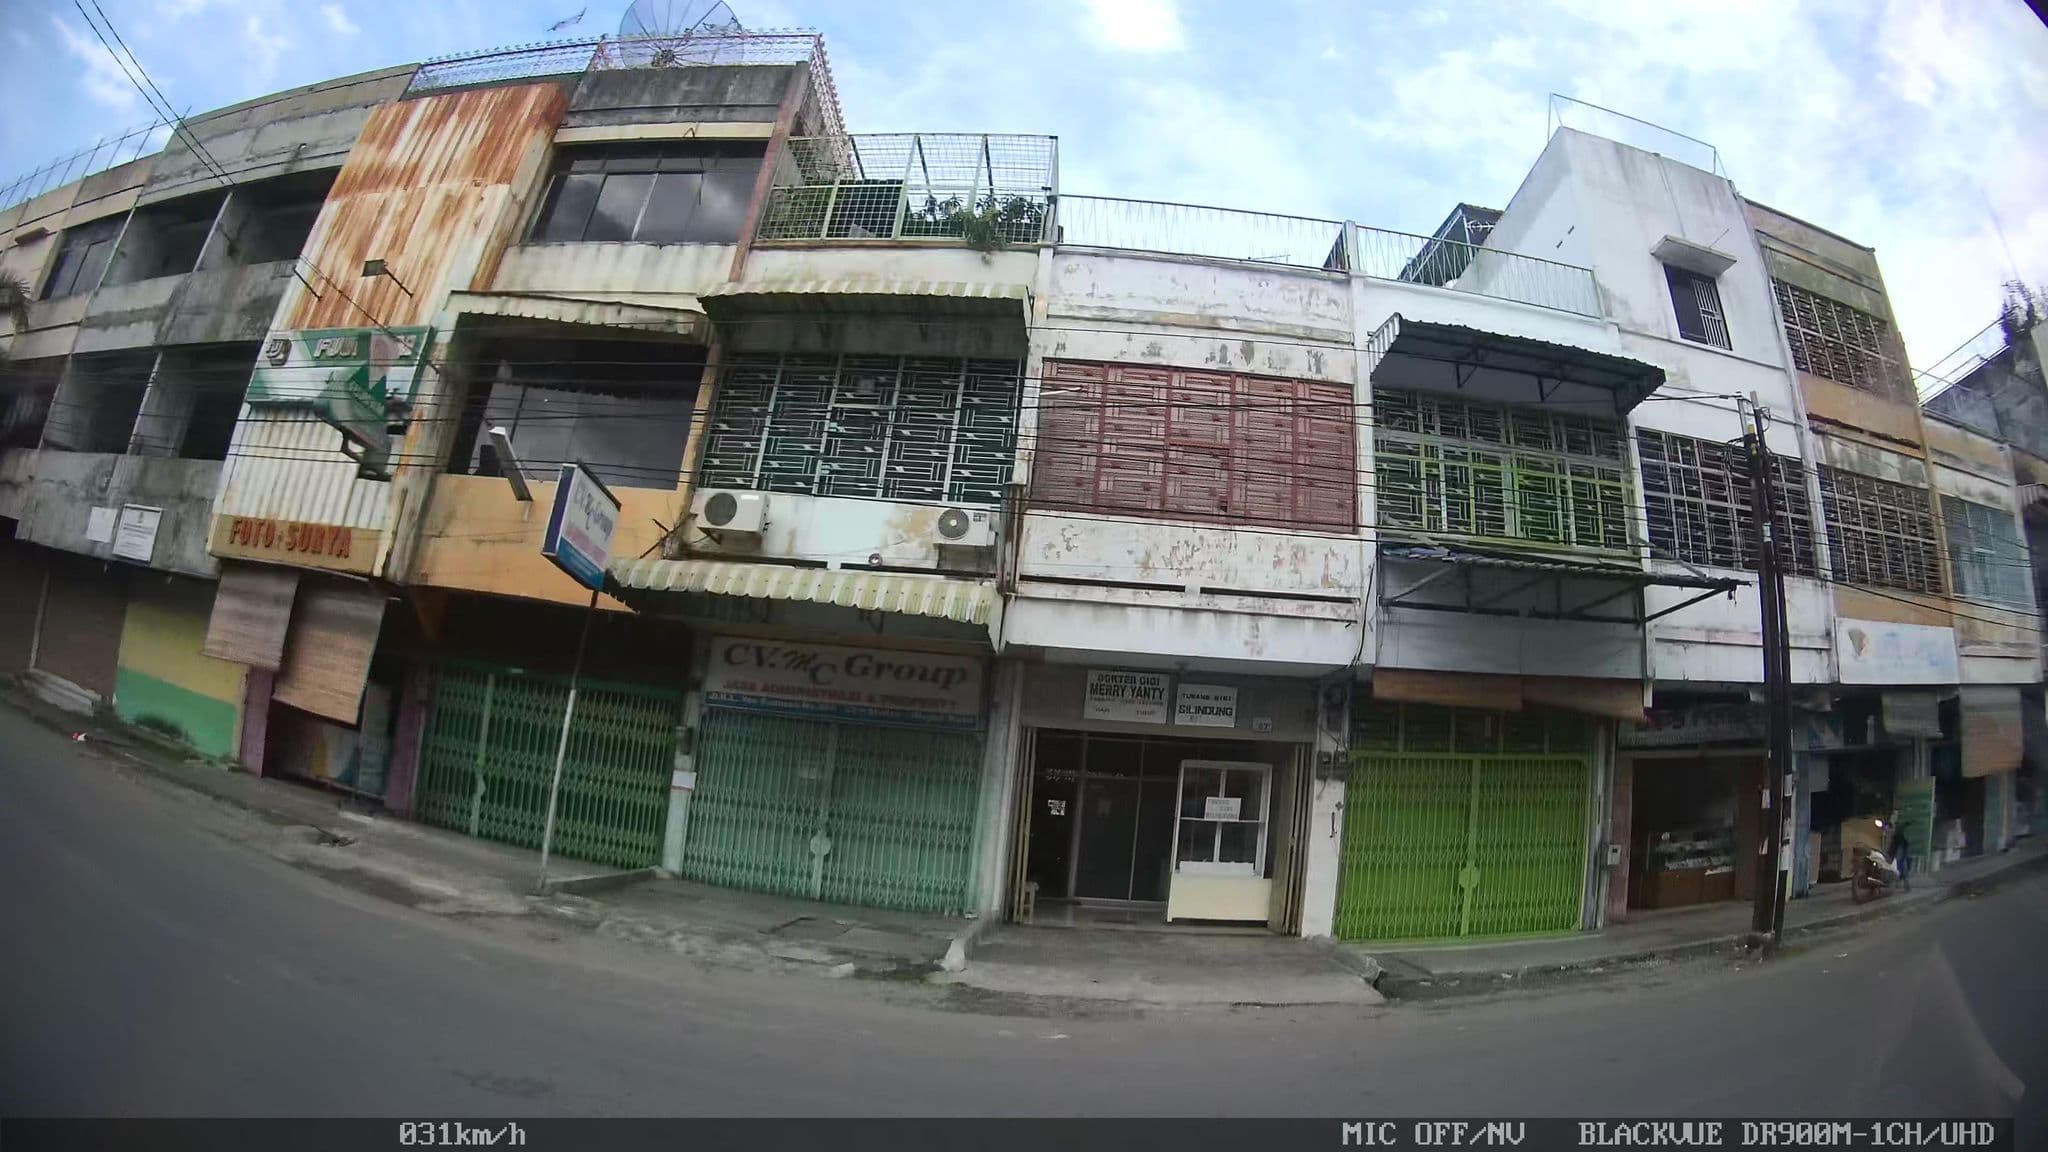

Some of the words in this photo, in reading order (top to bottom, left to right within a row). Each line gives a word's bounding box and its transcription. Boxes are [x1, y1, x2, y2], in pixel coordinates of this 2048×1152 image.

[313, 335, 359, 358] FUJI
[287, 522, 352, 559] SURYA
[844, 653, 968, 690] Group
[1097, 673, 1137, 684] DOKTER
[1139, 677, 1161, 686] GIGI
[1089, 682, 1127, 697] MERRY
[1130, 686, 1166, 701] YANTY
[1178, 704, 1233, 717] SILINDUNG
